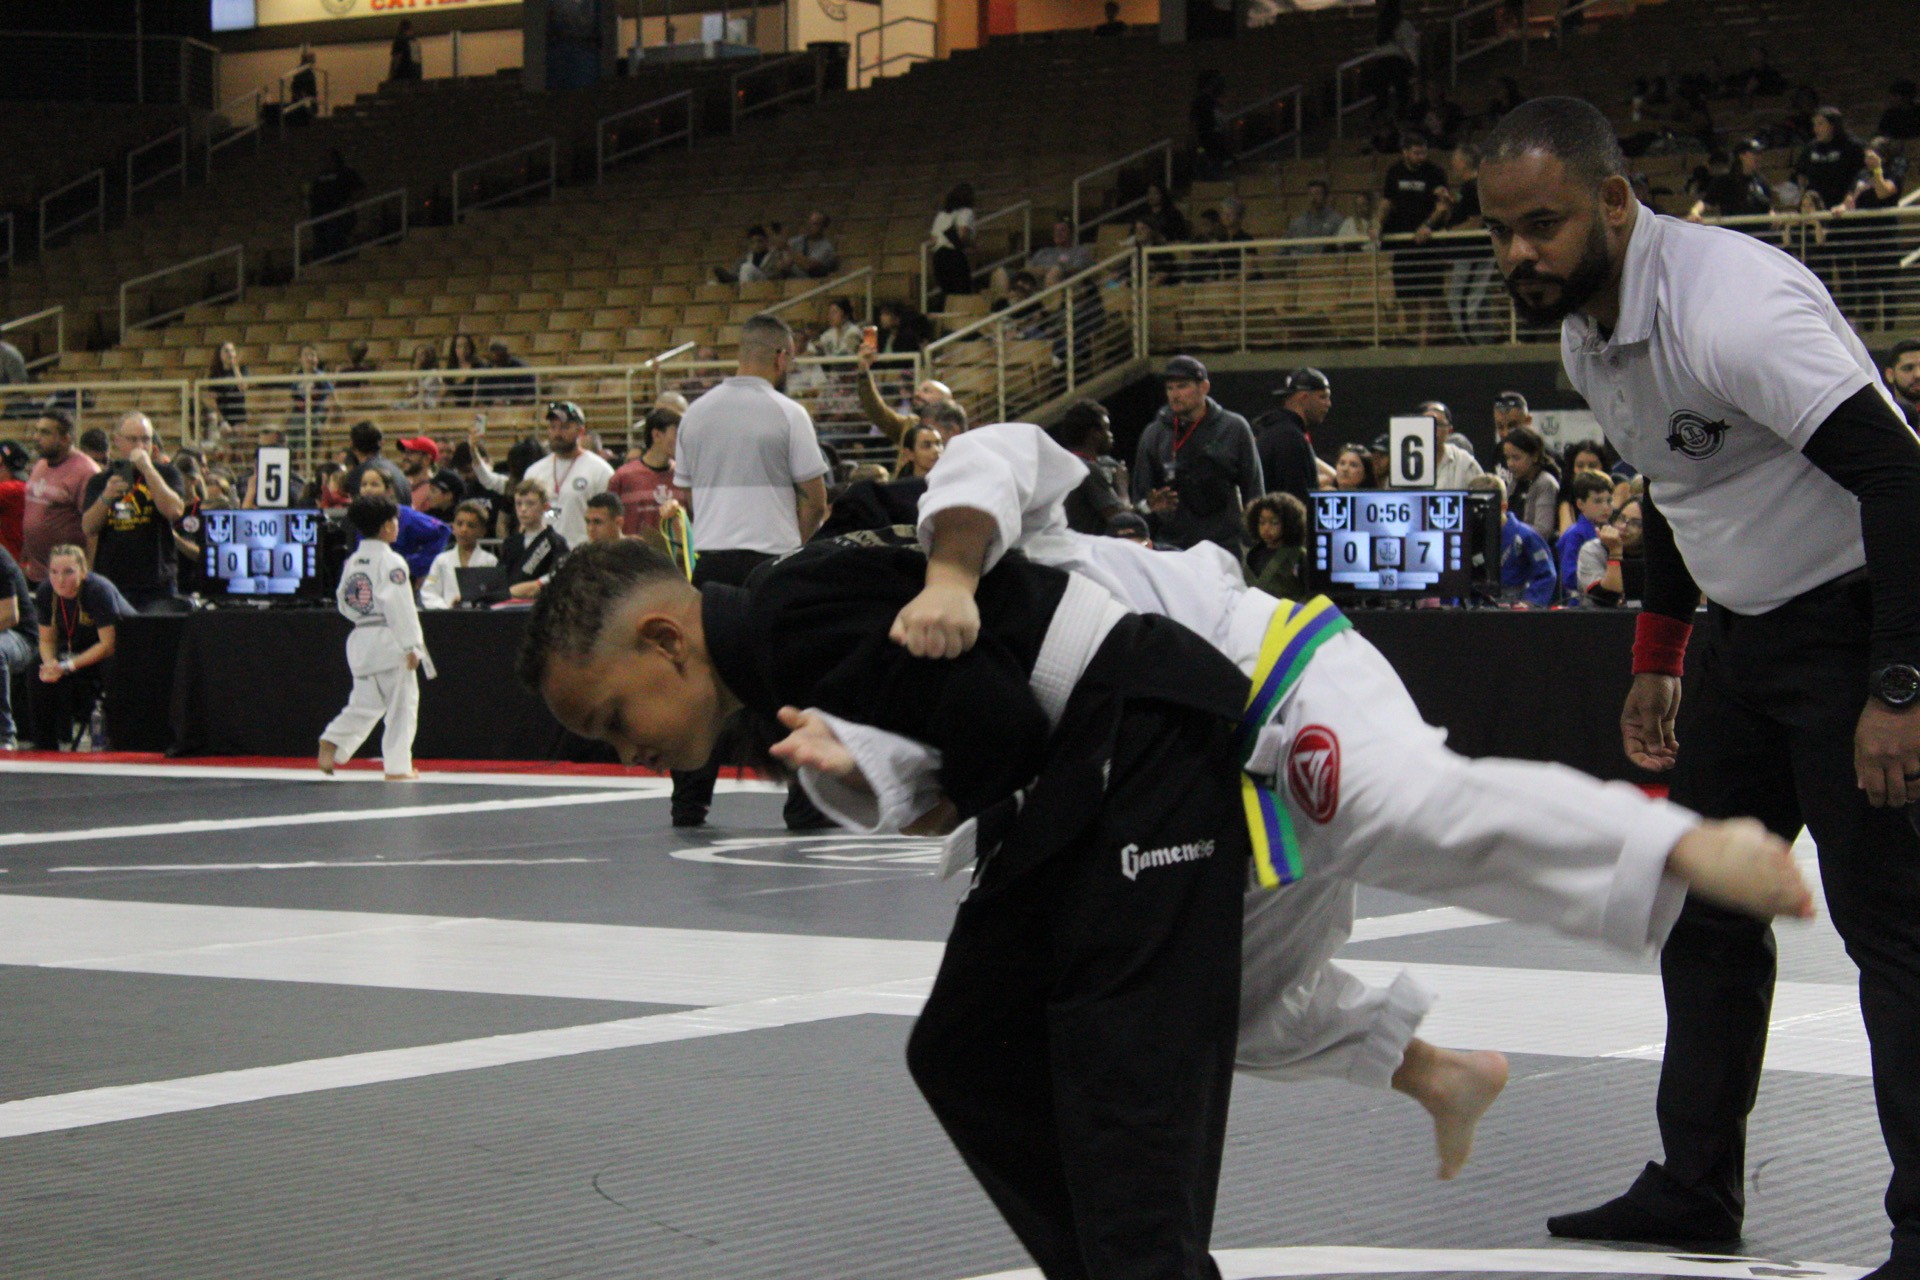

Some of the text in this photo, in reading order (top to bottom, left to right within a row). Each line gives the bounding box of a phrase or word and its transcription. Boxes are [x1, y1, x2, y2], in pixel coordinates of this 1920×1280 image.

[1400, 434, 1425, 482] 6
[265, 463, 282, 502] 5
[1366, 503, 1411, 523] 0:56
[244, 520, 278, 537] 3:00
[227, 552, 293, 571] 0 0
[1343, 541, 1431, 564] 0 7
[1381, 574, 1395, 585] VS
